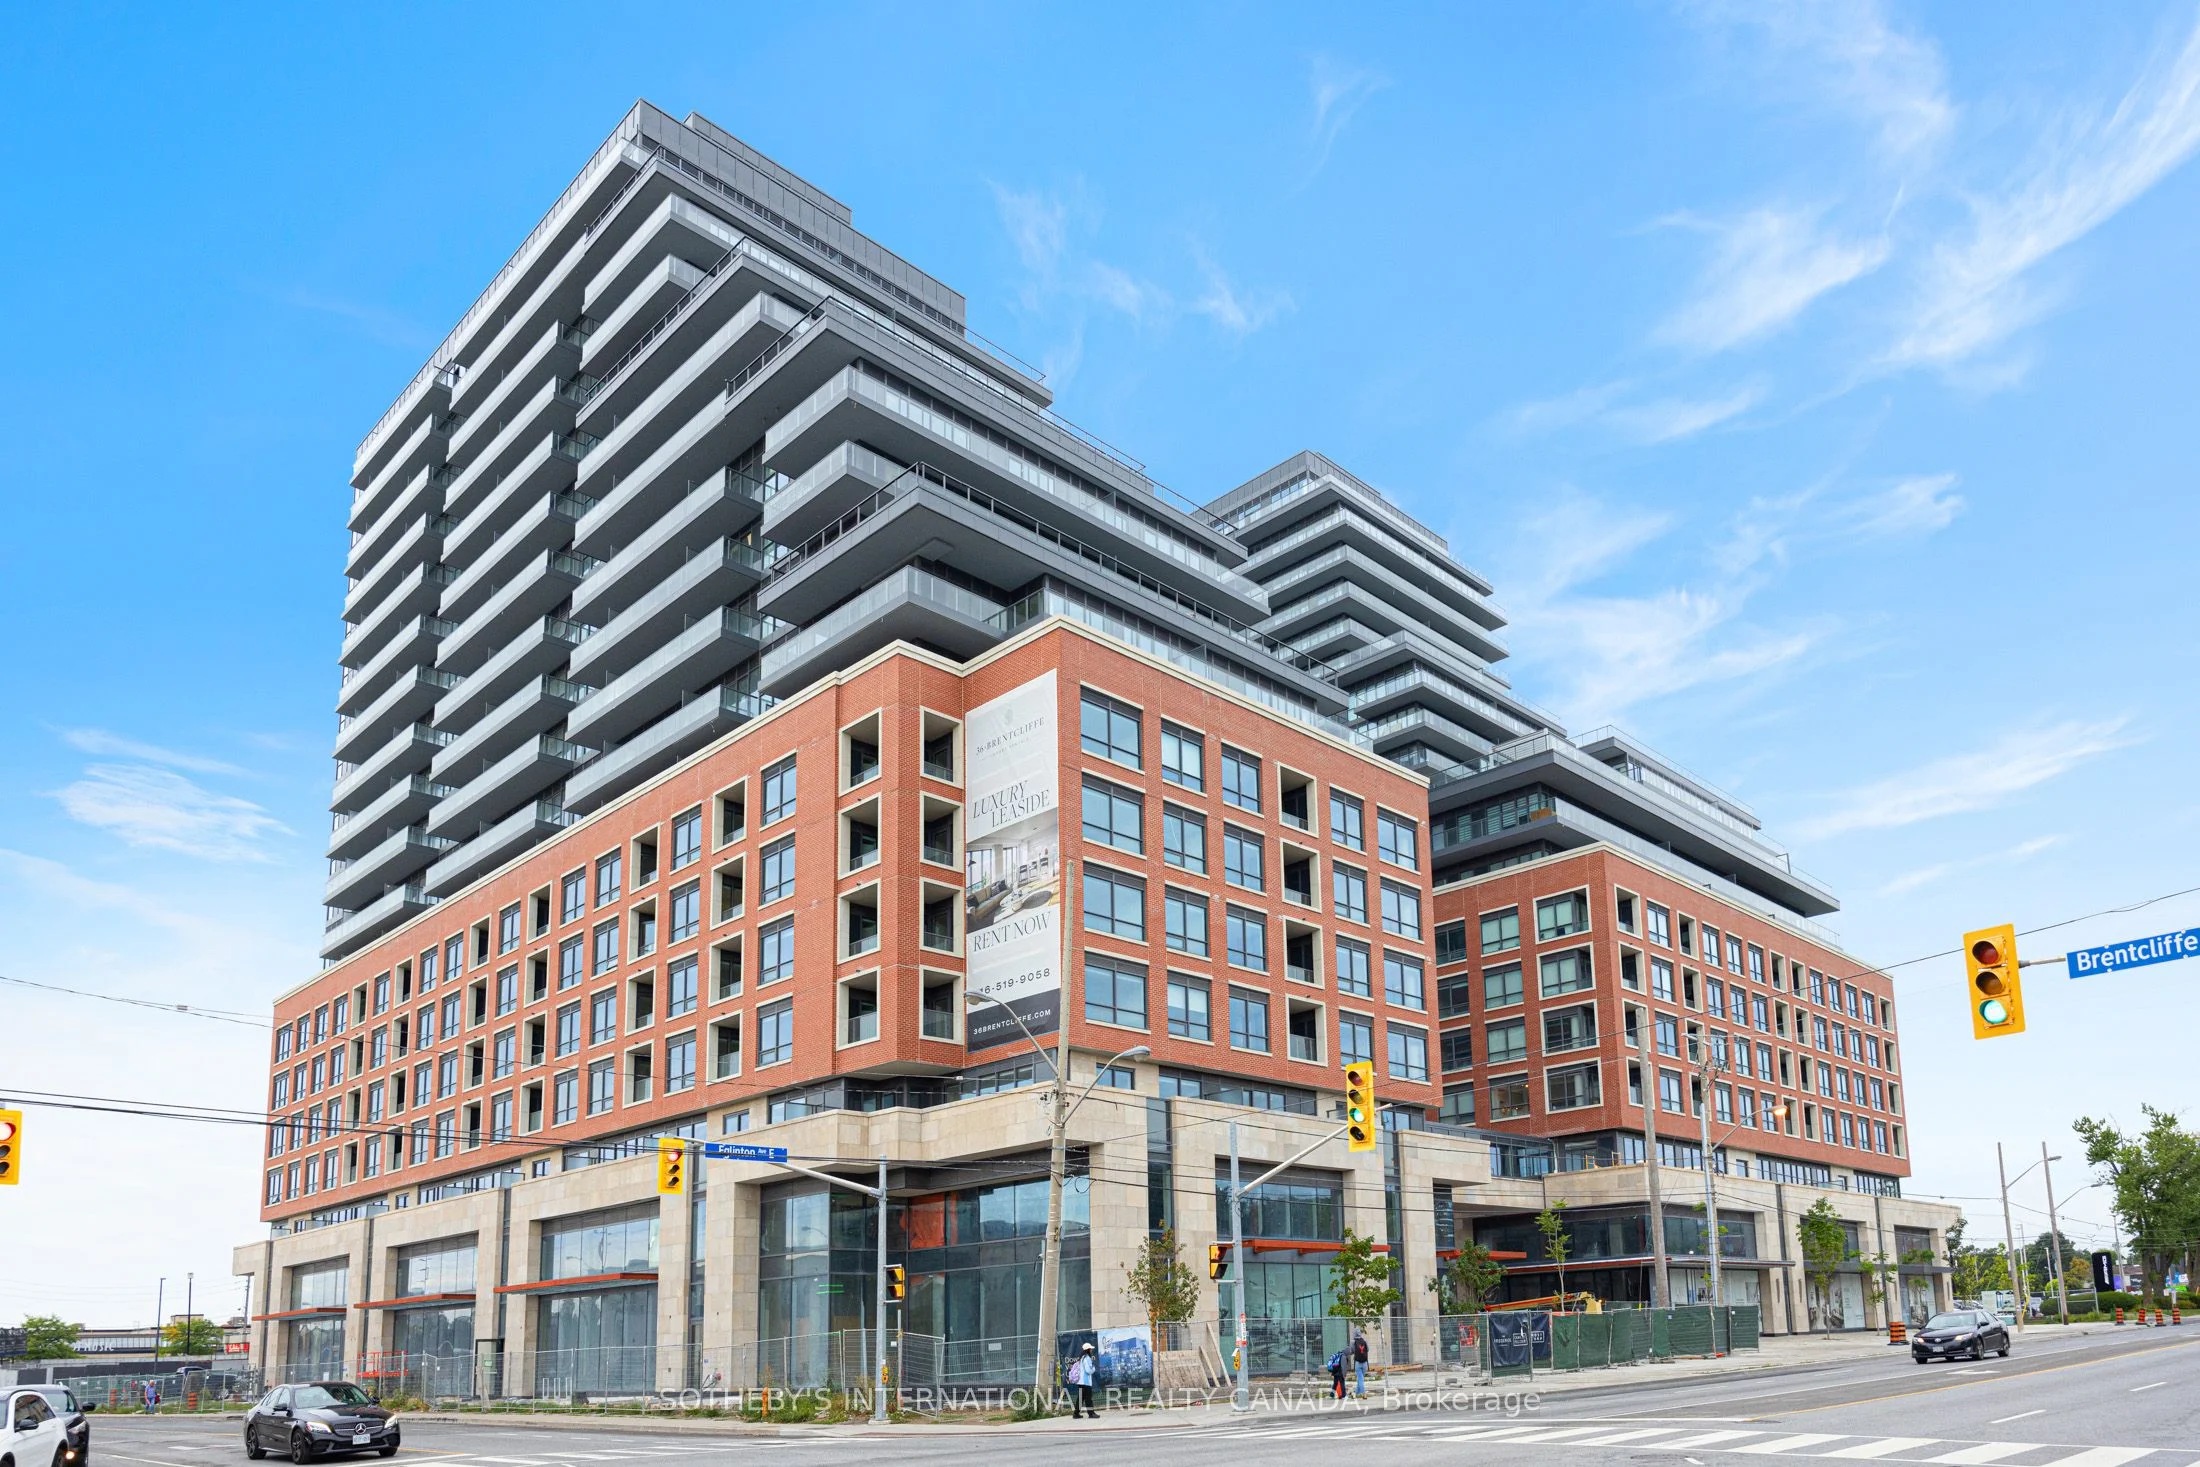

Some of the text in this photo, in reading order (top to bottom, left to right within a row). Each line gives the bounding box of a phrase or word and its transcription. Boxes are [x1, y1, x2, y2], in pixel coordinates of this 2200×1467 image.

[973, 779, 1028, 819] LUXURY
[991, 789, 1050, 828] LEASIDE
[973, 911, 1051, 953] RENT NOW
[2076, 932, 2199, 972] Brentcliffe
[973, 1008, 1051, 1036] 36BRENTCLFFE.COM
[768, 1148, 775, 1159] E
